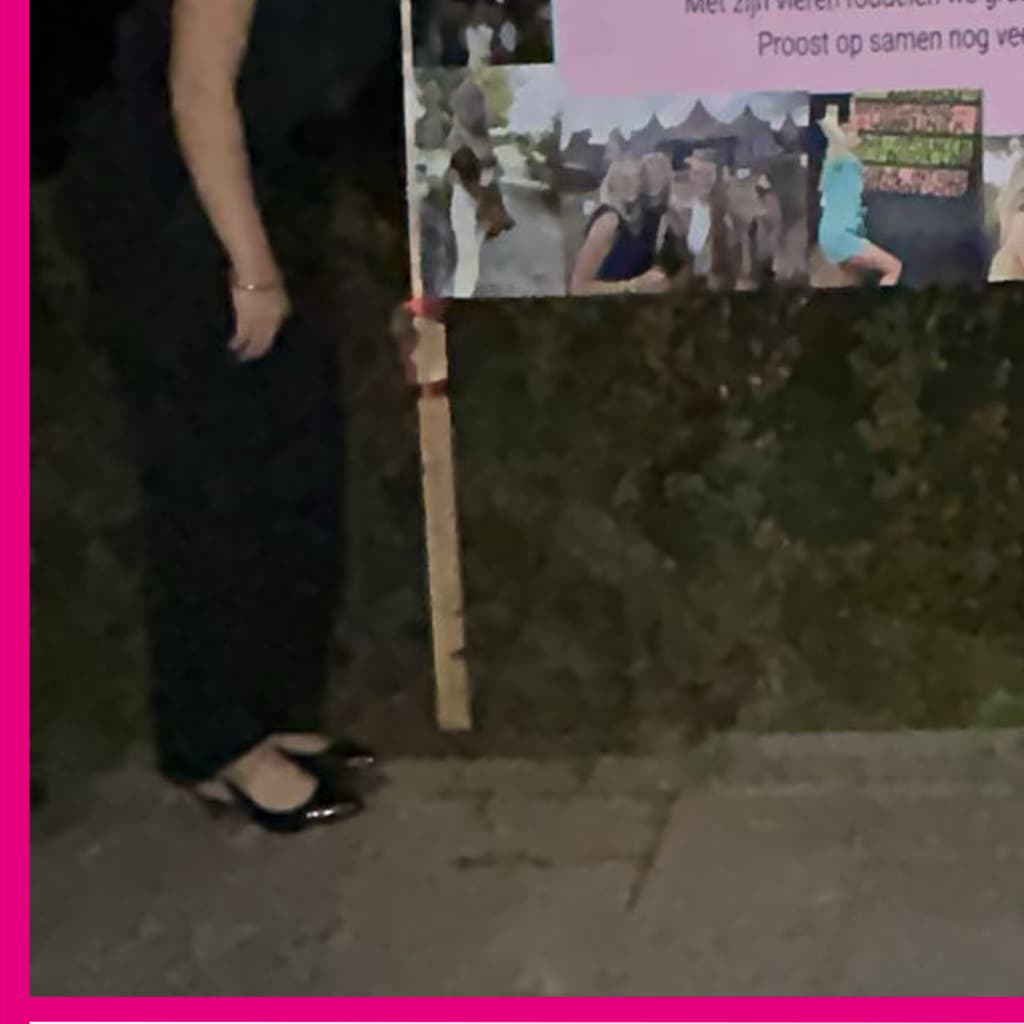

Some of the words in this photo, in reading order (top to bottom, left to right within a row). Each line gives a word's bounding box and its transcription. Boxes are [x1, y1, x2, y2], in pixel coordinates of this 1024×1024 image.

[759, 31, 830, 57] Proost
[836, 34, 863, 59] op
[869, 30, 943, 53] samen
[950, 28, 991, 55] nog
